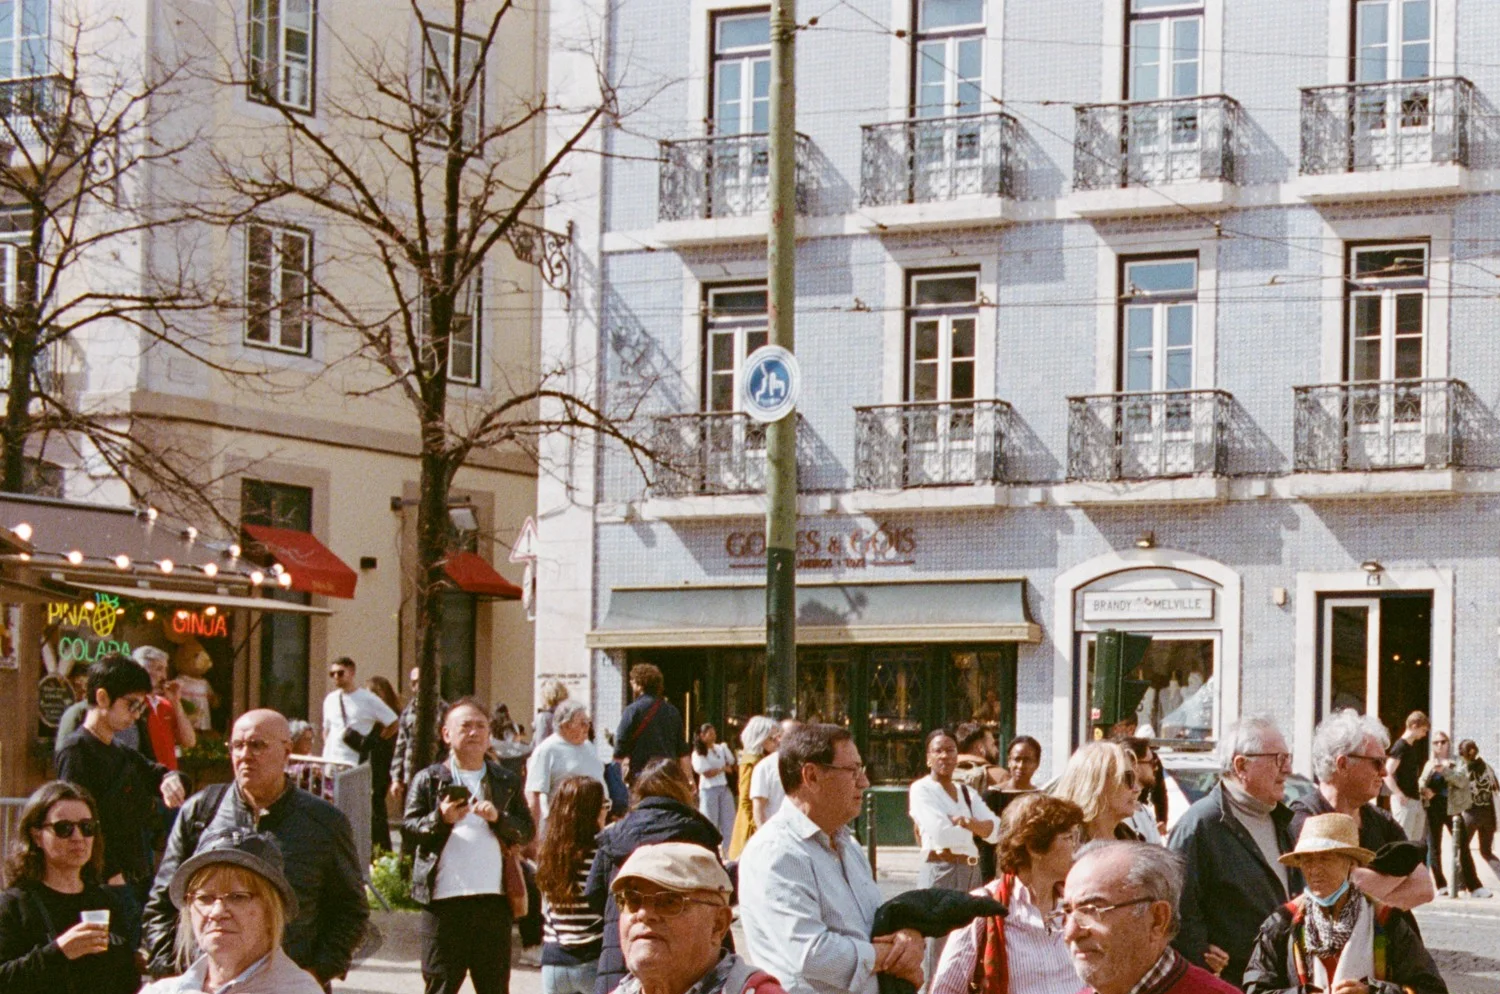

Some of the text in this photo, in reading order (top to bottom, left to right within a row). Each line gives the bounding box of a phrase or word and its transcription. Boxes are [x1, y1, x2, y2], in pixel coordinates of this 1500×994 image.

[726, 522, 917, 558] GOES & GÓIS
[1093, 598, 1202, 612] BRANDY MELVILLE
[173, 610, 227, 637] GINJA
